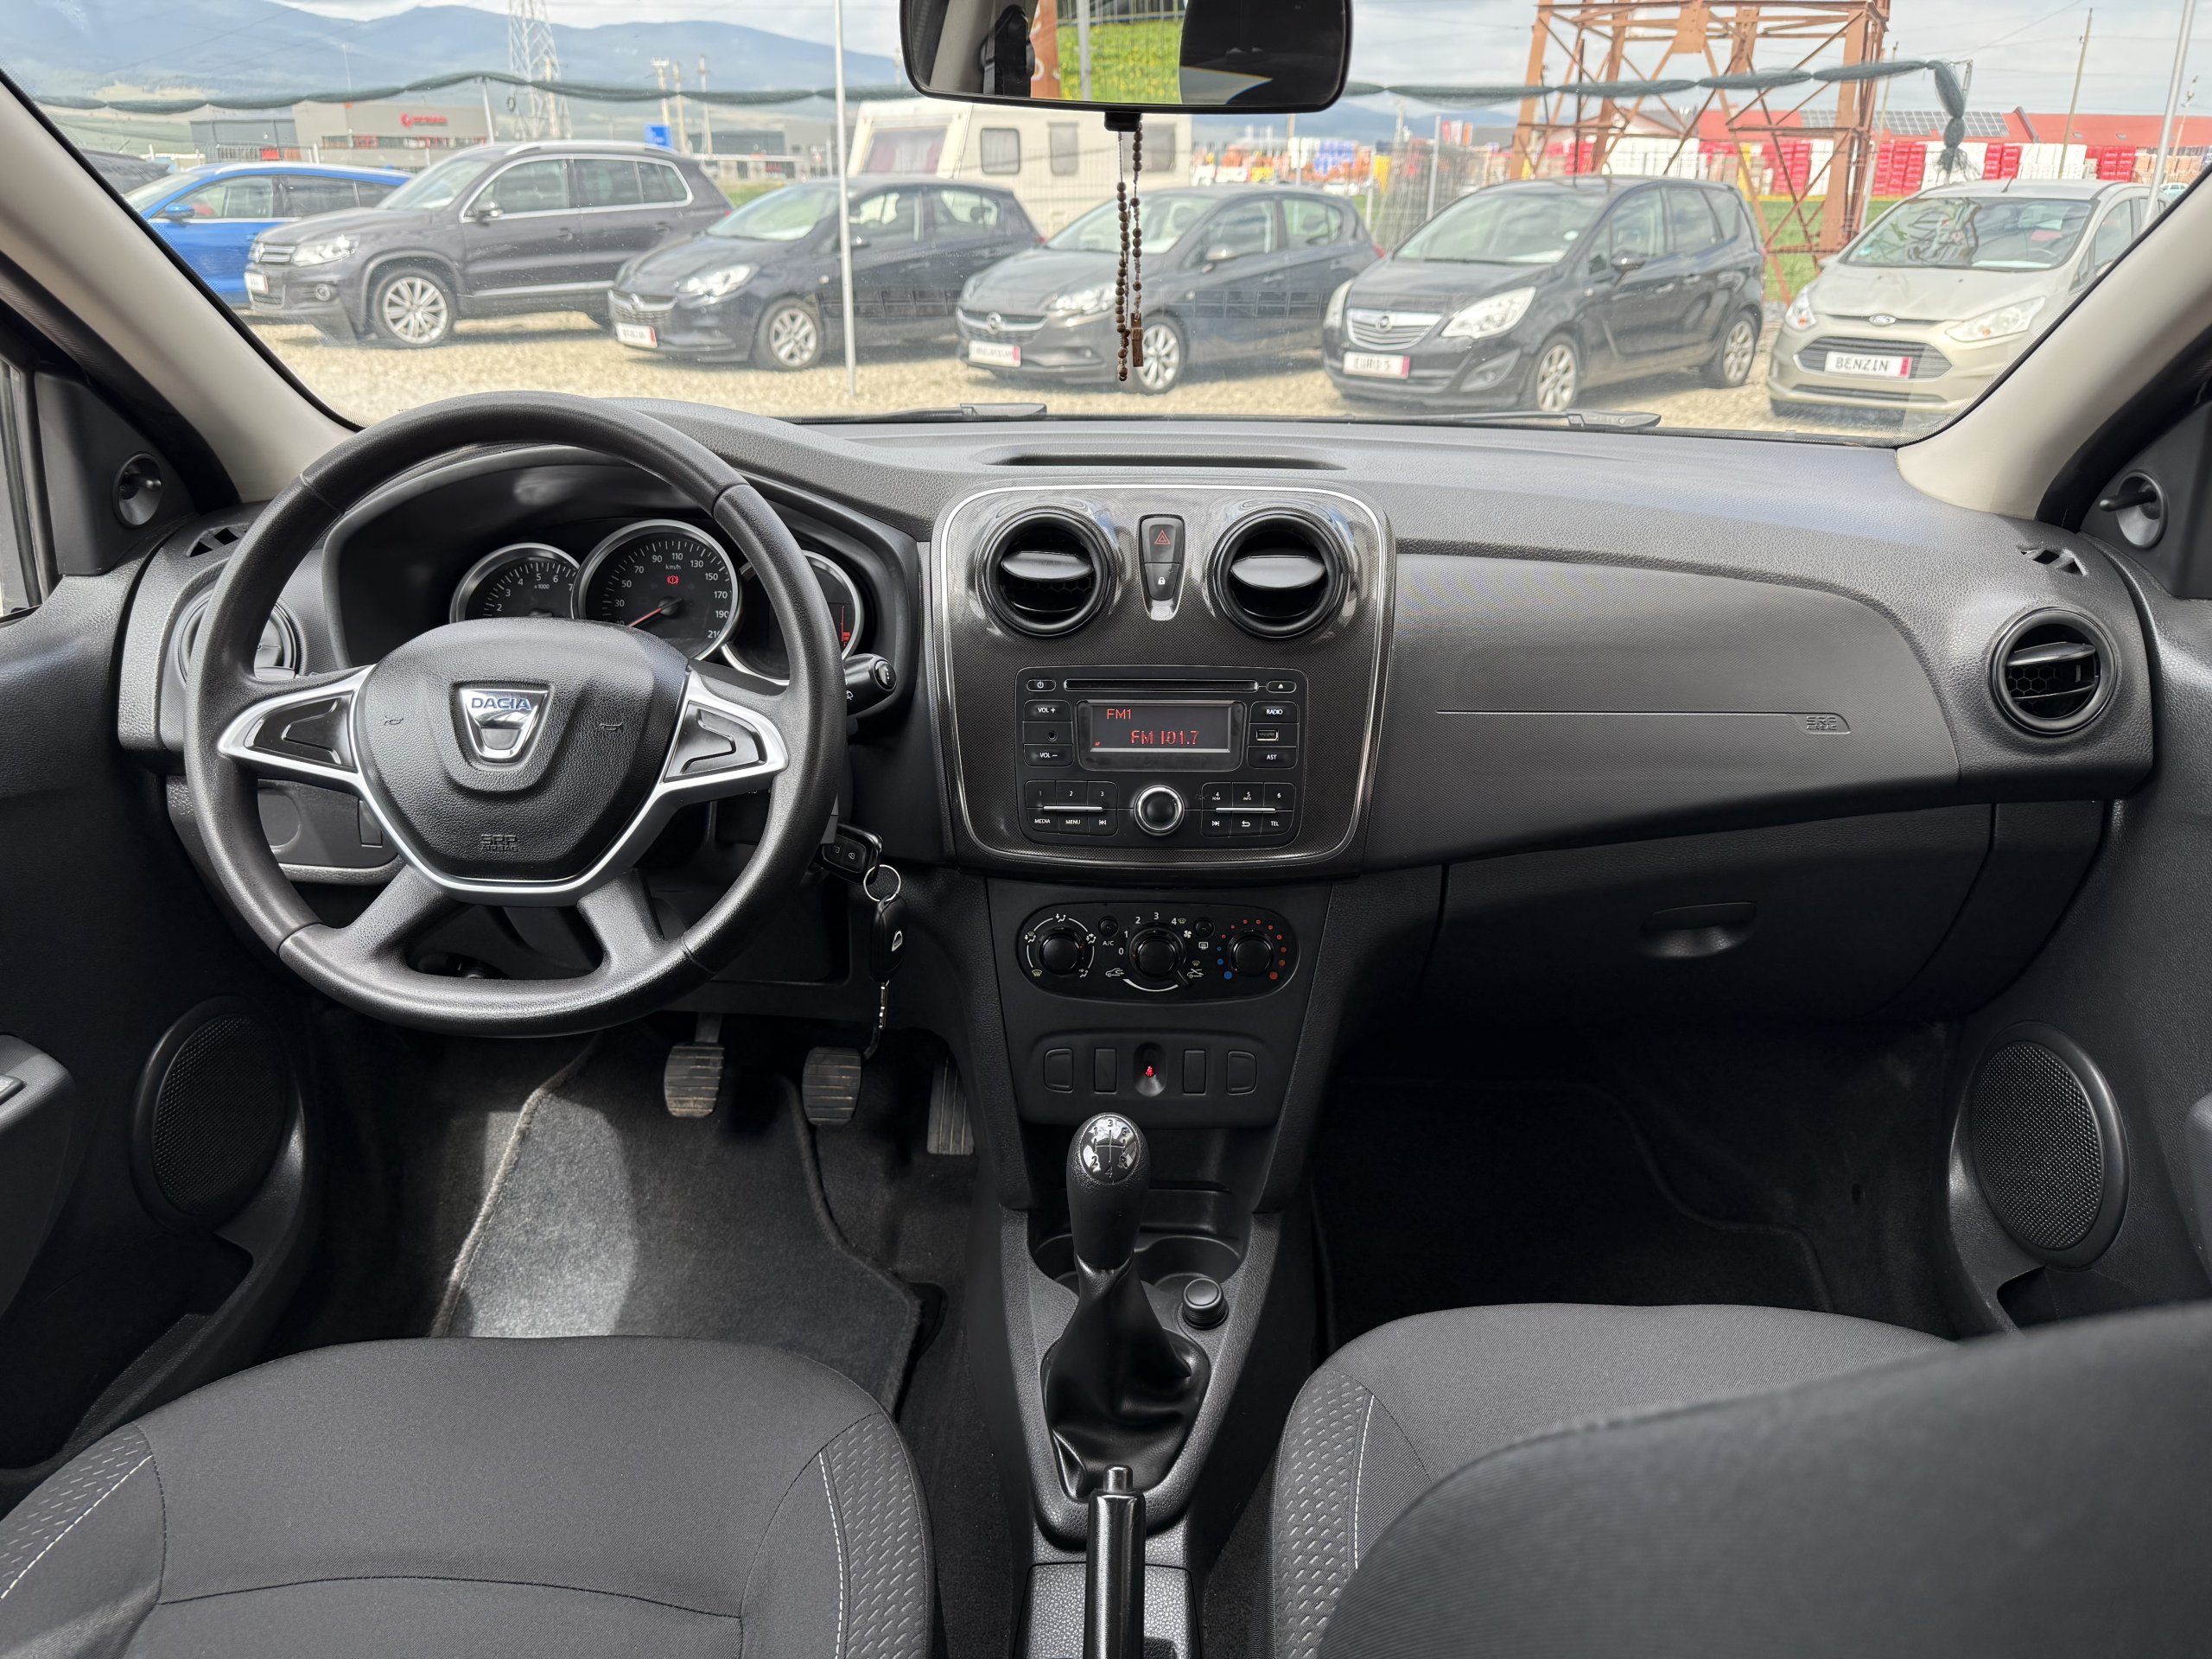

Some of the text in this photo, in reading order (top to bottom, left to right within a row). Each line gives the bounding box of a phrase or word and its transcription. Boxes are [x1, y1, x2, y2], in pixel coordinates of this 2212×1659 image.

[1835, 356, 1889, 372] BENZIN
[671, 552, 683, 561] 110
[536, 573, 542, 582] 5
[553, 575, 559, 583] 6
[705, 573, 719, 582] 150
[568, 583, 574, 592] 7
[621, 580, 632, 588] 50
[505, 588, 512, 597] 3
[714, 591, 728, 600] 170
[497, 603, 503, 612] 2
[715, 610, 729, 619] 190
[471, 697, 532, 710] DACIA
[1107, 709, 1131, 719] FM1
[1131, 730, 1198, 745] FM 101.7
[1135, 916, 1141, 925] 2
[1154, 912, 1159, 920] 3
[1171, 917, 1177, 925] 4
[1124, 930, 1128, 938] 1
[1118, 947, 1124, 956] 0
[1093, 1126, 1098, 1135] 1
[1122, 1127, 1128, 1136] 5
[1090, 1155, 1099, 1167] 2
[1117, 1155, 1128, 1169] R
[1104, 1166, 1113, 1177] 4
